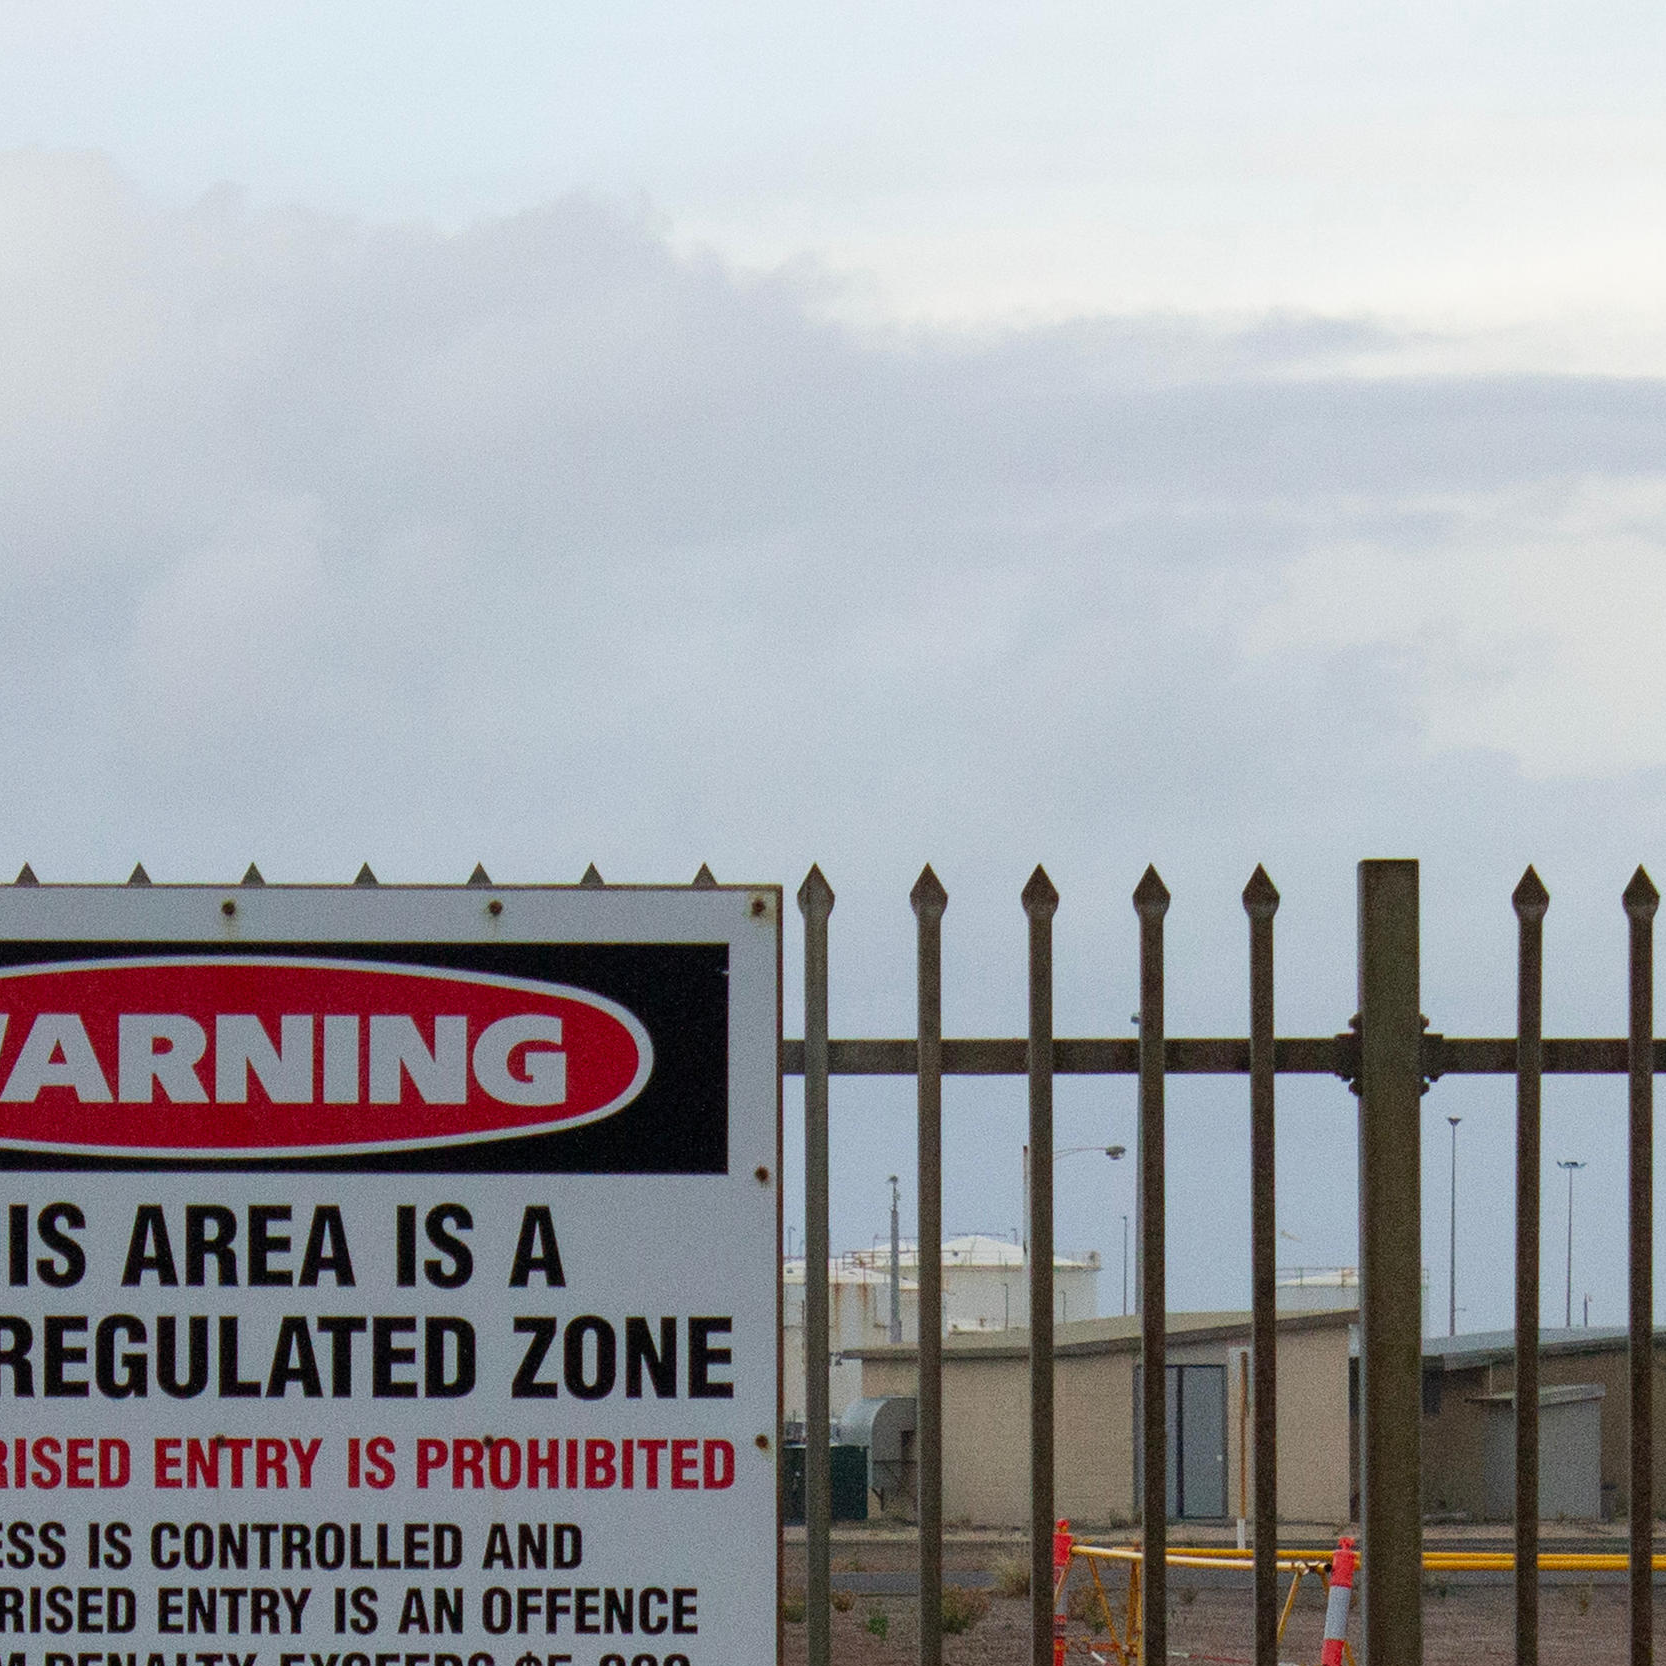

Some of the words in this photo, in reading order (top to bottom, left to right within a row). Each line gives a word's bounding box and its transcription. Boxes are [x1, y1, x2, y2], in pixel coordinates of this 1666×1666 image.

[121, 1204, 356, 1287] AREA
[397, 1203, 474, 1289] IS
[509, 1205, 566, 1288] A
[511, 1315, 734, 1401] ZONE
[154, 1435, 322, 1489] ENTRY
[348, 1436, 396, 1490] IS
[416, 1436, 735, 1491] PROHIBITED
[88, 1521, 132, 1571] IS
[151, 1522, 463, 1571] CONTROLLED
[482, 1523, 583, 1570] AND
[158, 1587, 312, 1635] ENTRY
[334, 1586, 379, 1636] IS
[398, 1587, 464, 1634] AN
[482, 1586, 698, 1636] OFFENCE
